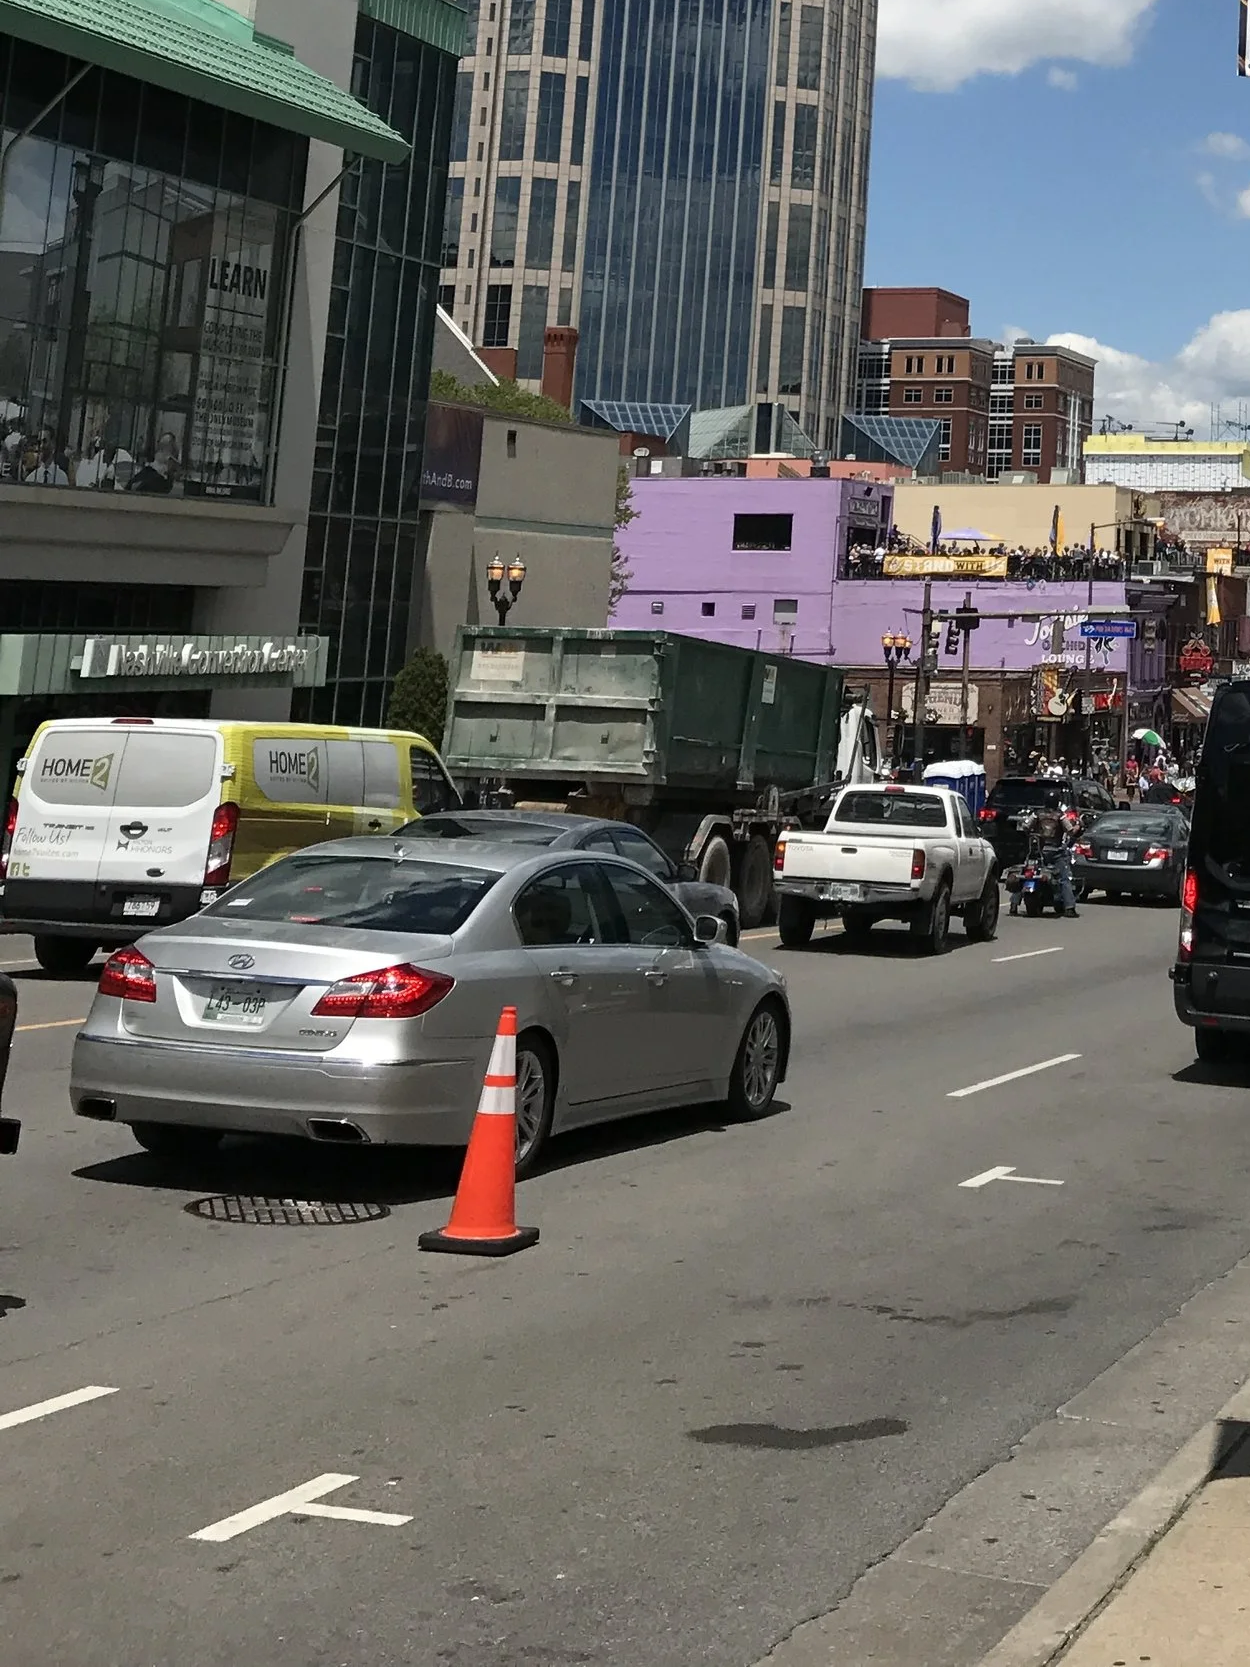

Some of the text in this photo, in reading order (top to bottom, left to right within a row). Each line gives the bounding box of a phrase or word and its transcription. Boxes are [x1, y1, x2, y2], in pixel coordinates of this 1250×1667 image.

[209, 258, 267, 300] LEARN
[423, 471, 473, 490] thAndB.com
[904, 560, 954, 572] STAND
[955, 562, 984, 571] WITH
[1042, 640, 1086, 651] OCHID
[106, 642, 308, 676] Nashville Convention Center
[15, 827, 71, 845] Follow Us!
